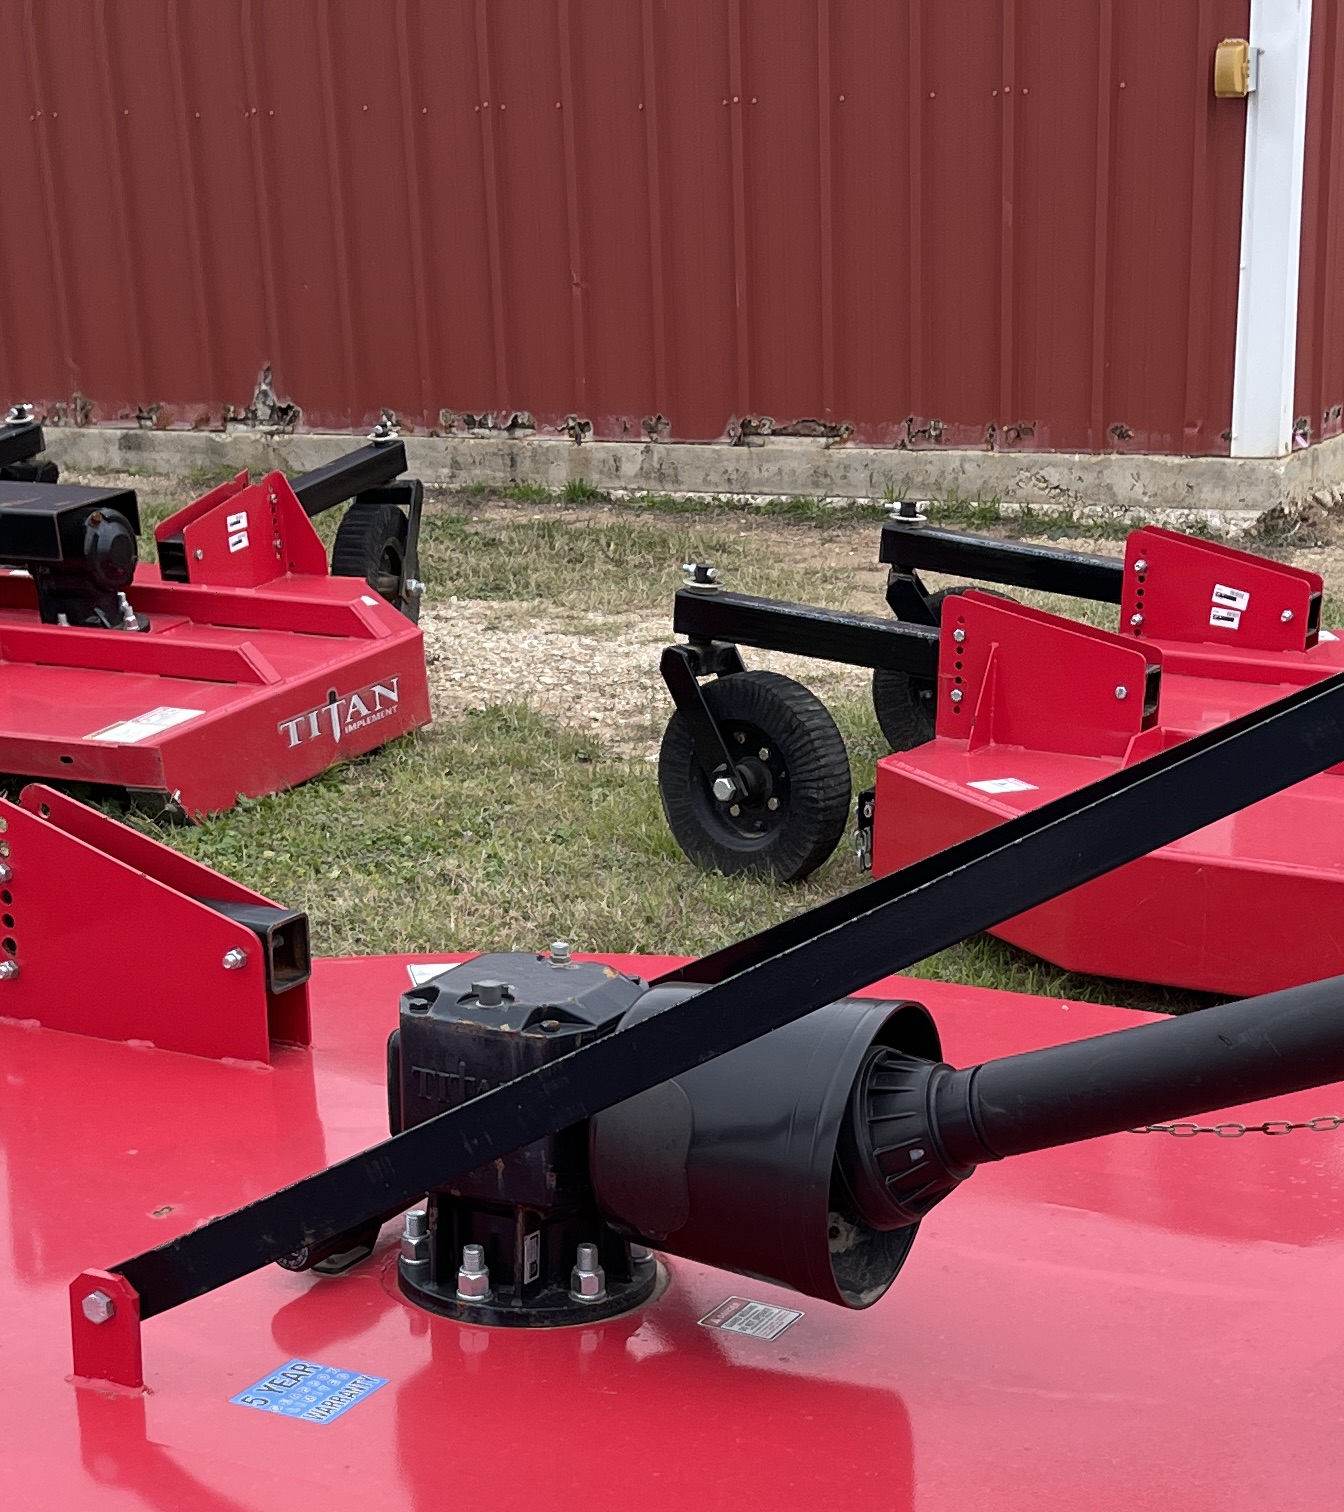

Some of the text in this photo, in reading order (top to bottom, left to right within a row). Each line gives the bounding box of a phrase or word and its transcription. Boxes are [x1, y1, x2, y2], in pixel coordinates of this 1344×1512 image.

[279, 677, 399, 748] TITAN
[345, 704, 398, 733] IMPLEMENT
[241, 1395, 269, 1407] 5
[256, 1362, 322, 1394] YEAR
[303, 1374, 380, 1421] WARRANTY
